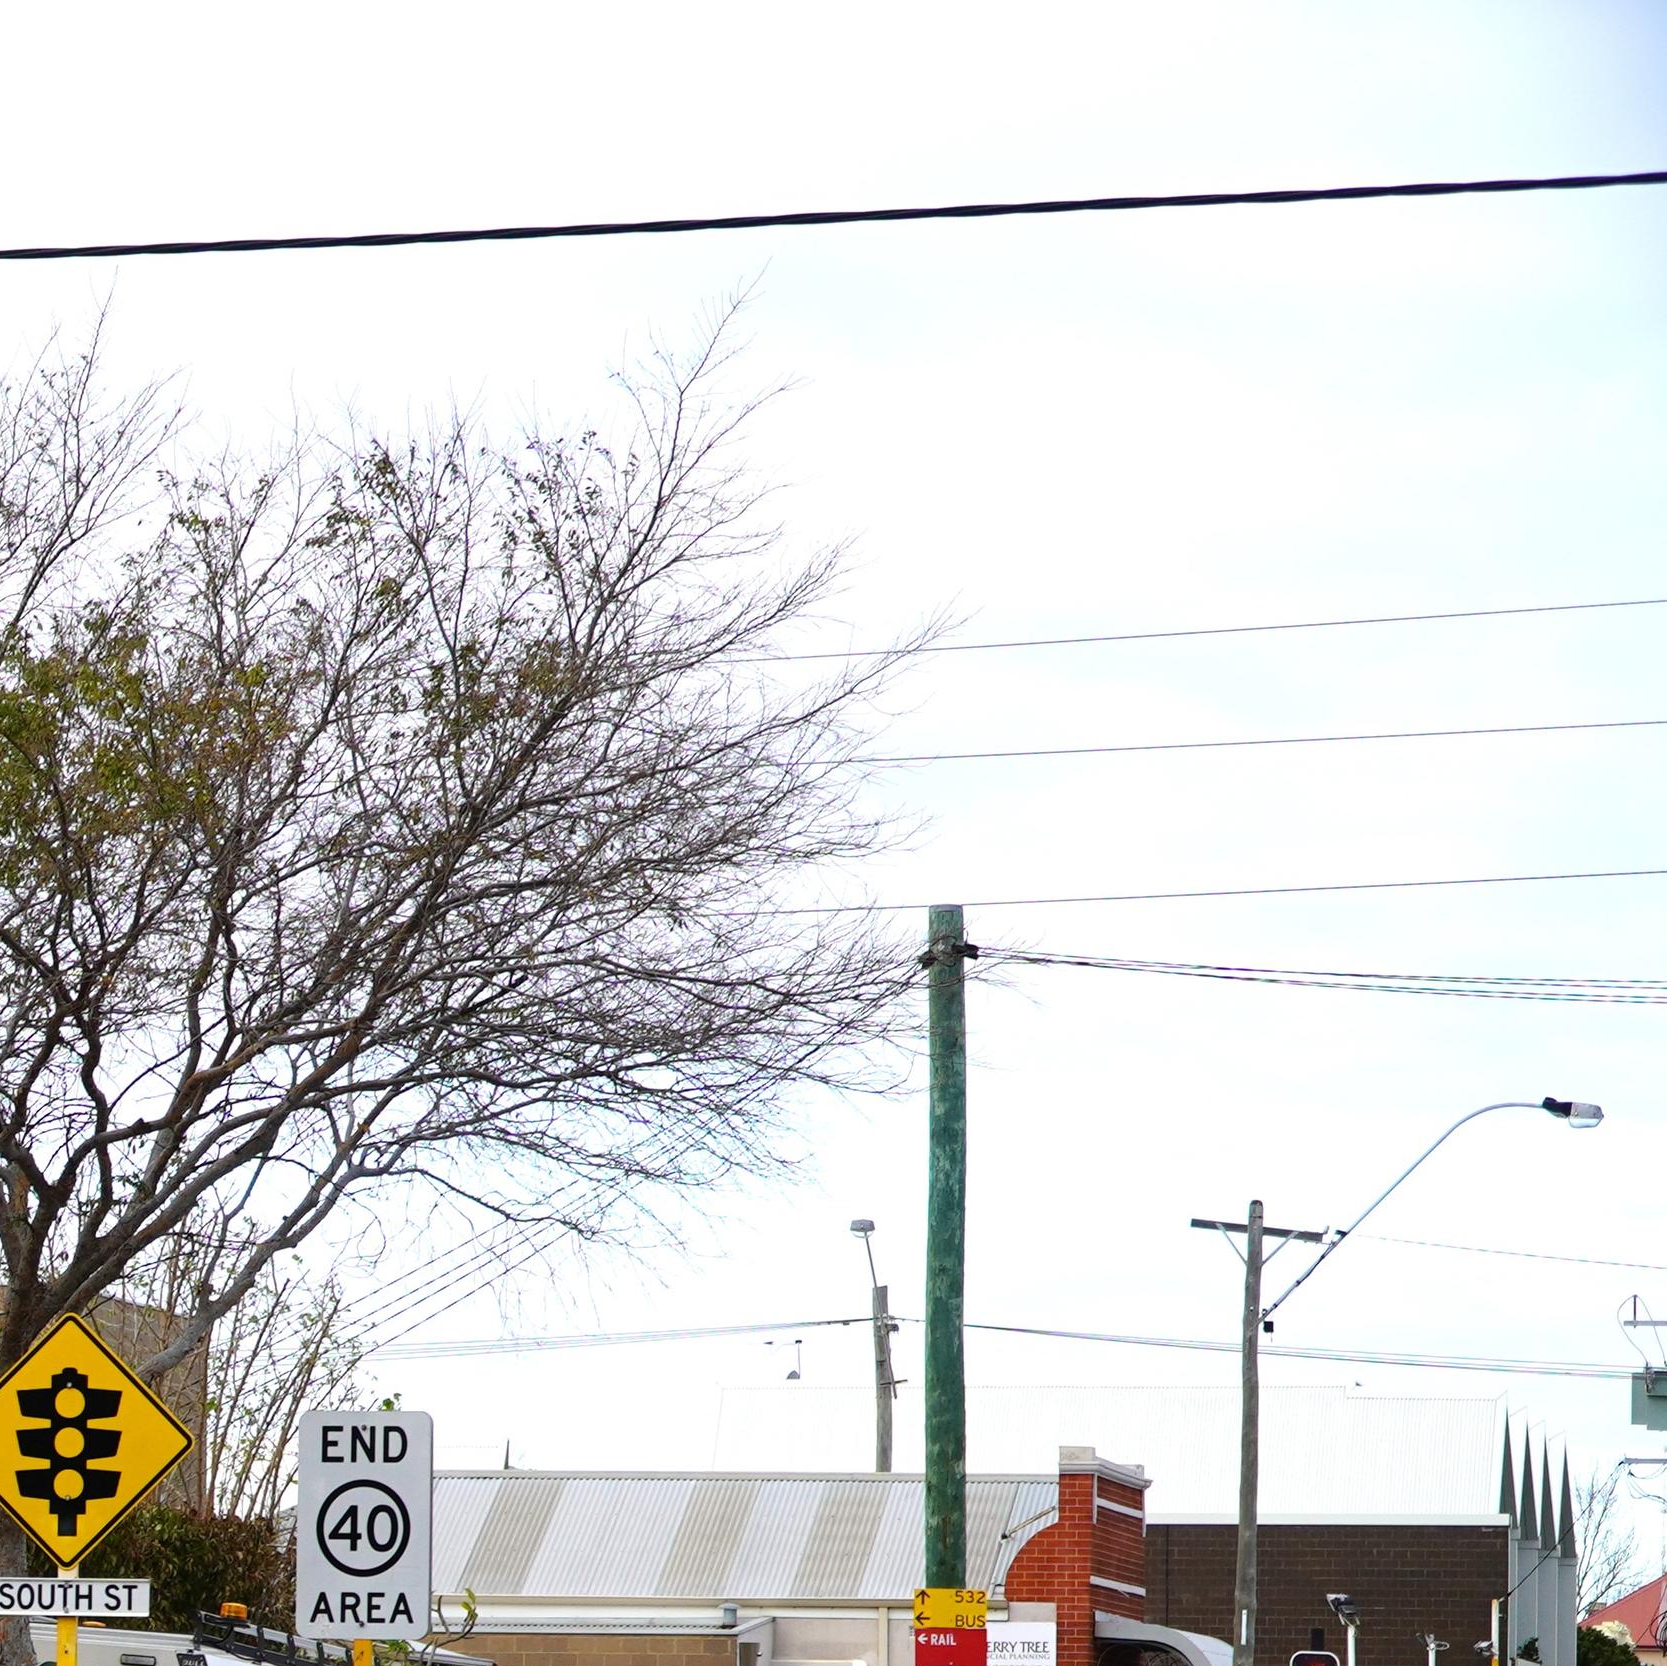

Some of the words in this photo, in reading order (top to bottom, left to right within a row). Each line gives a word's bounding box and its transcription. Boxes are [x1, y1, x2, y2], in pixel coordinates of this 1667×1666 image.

[322, 1425, 407, 1463] END
[328, 1504, 398, 1553] 40
[105, 1583, 140, 1612] ST
[955, 1591, 985, 1604] 532
[310, 1592, 414, 1625] AREA
[955, 1615, 986, 1628] BUS
[930, 1633, 957, 1646] RAIL
[1020, 1641, 1050, 1653] TREE
[1009, 1653, 1051, 1661] PLANNING
